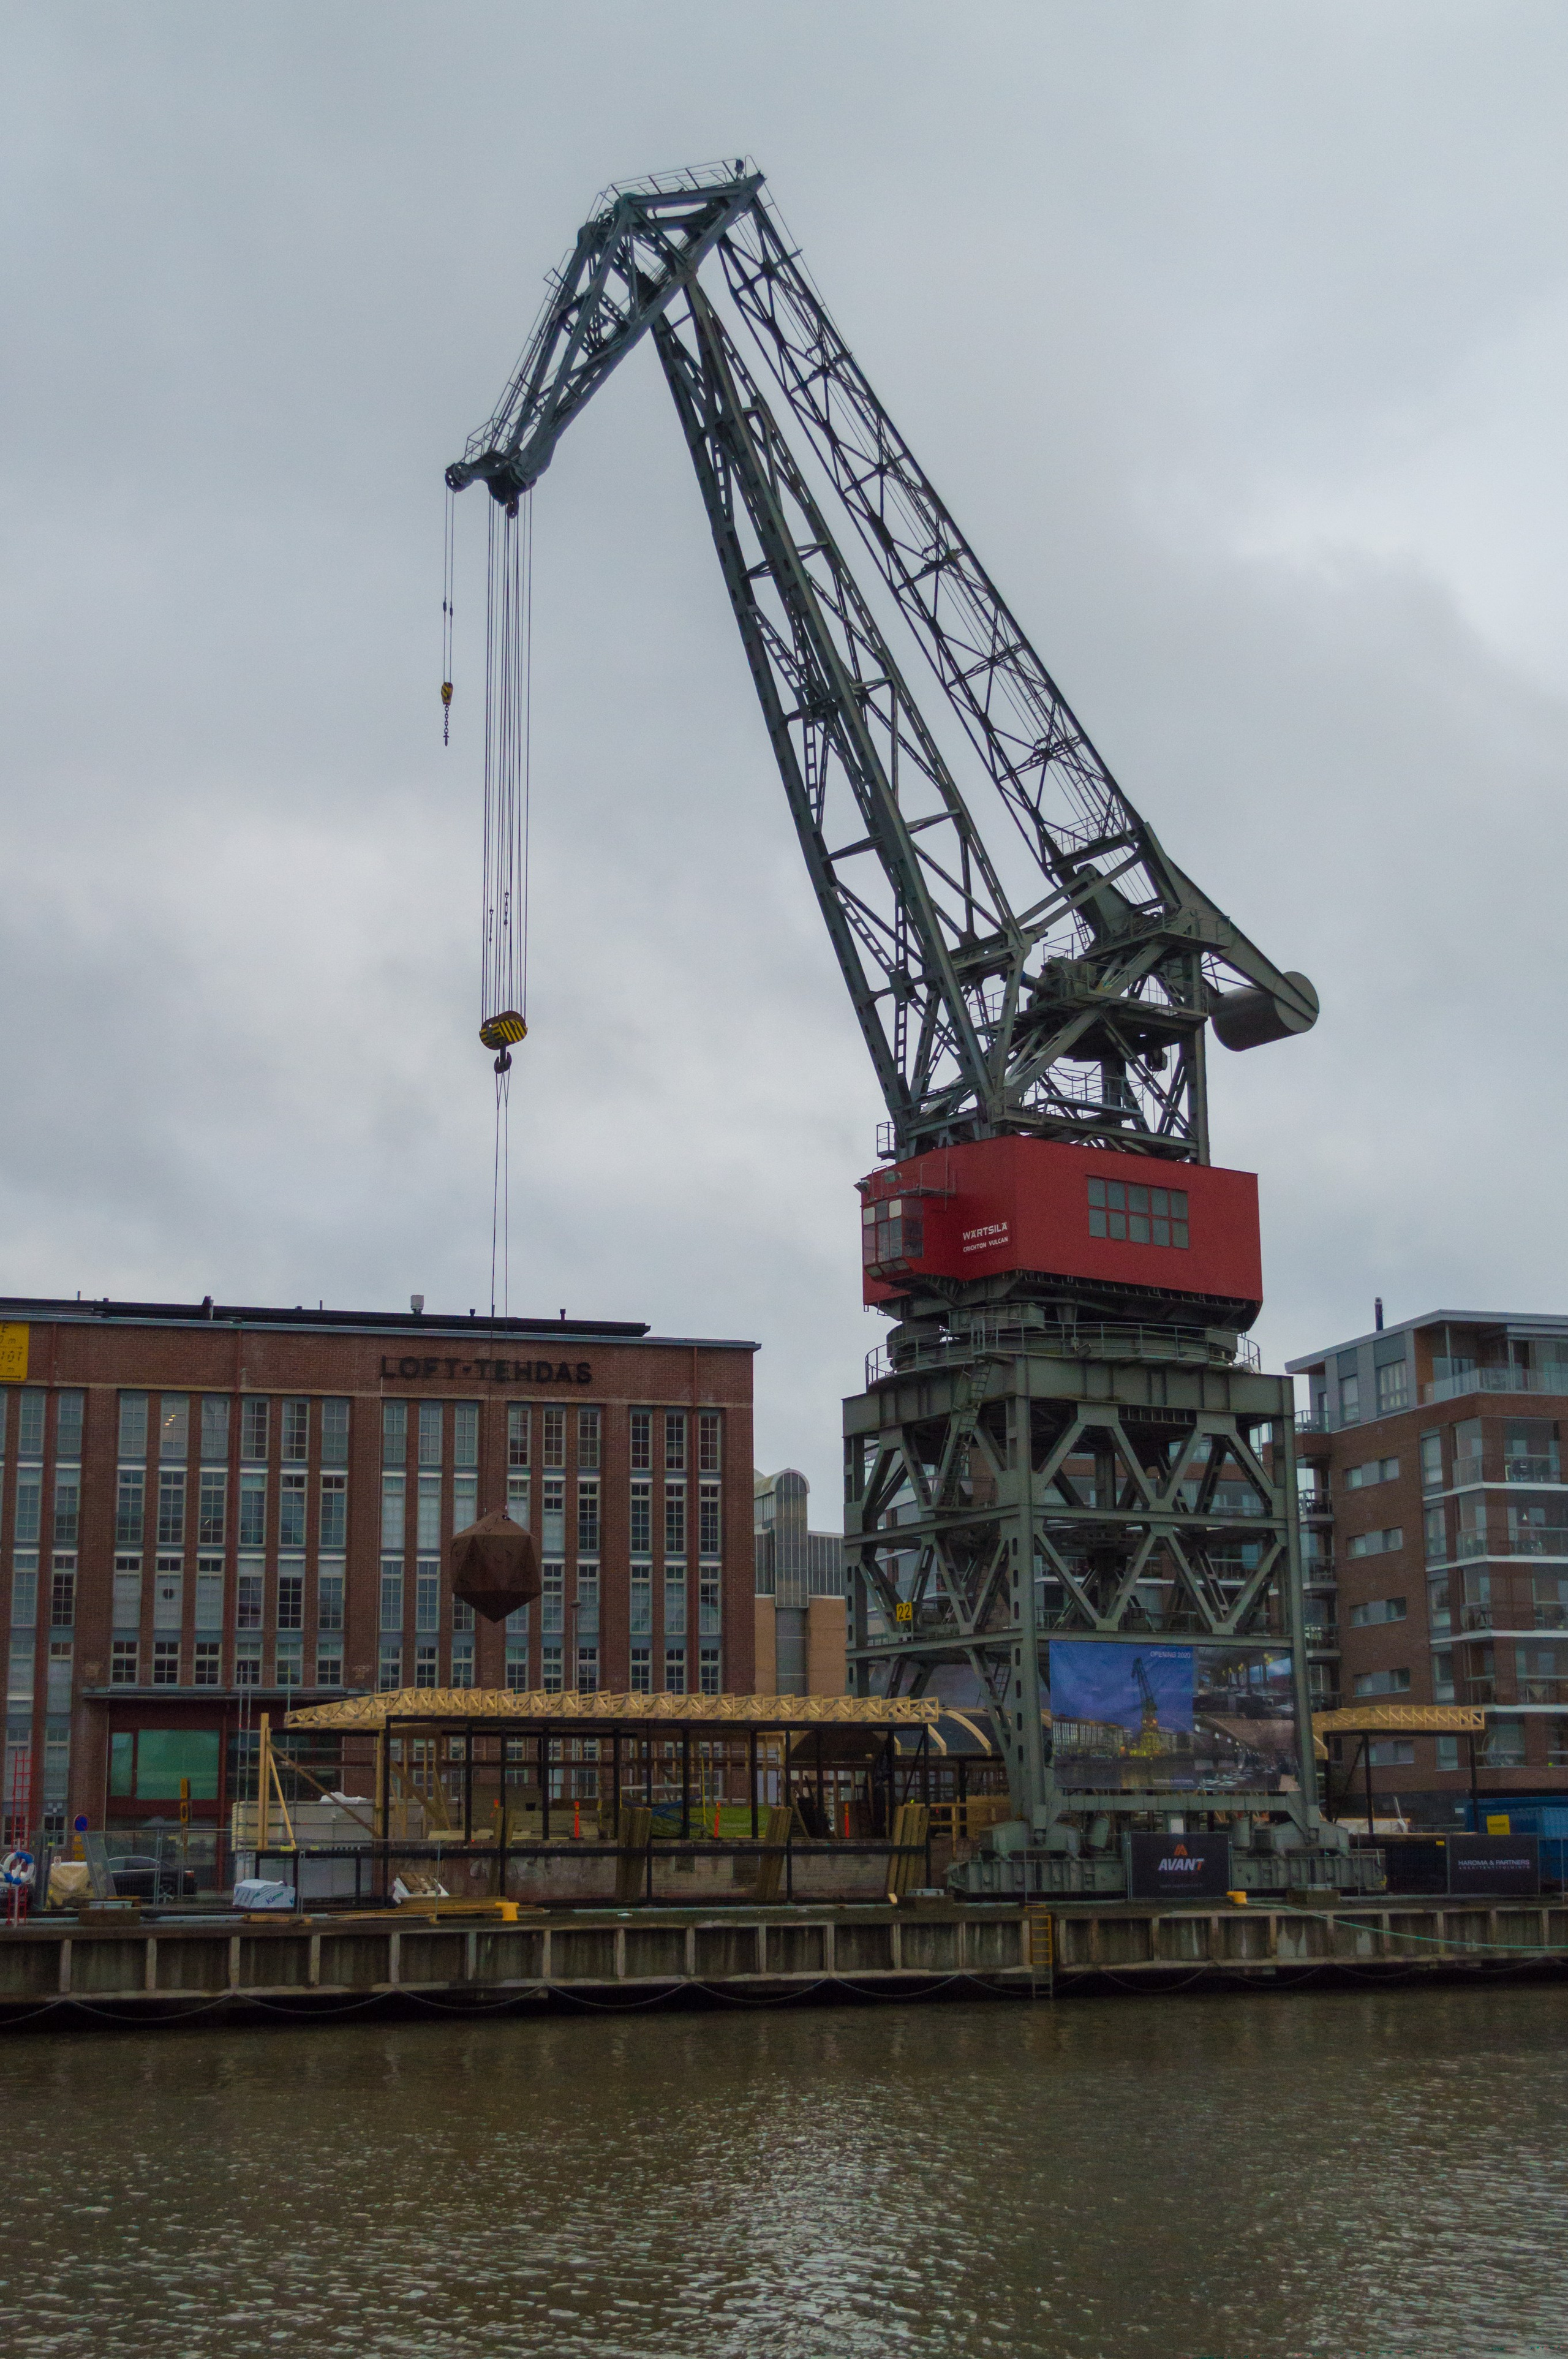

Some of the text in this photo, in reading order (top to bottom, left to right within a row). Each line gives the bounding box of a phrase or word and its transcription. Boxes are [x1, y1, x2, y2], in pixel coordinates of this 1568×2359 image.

[962, 1222, 1008, 1240] WÄRTSILÄ
[963, 1236, 1008, 1252] CRICHTON VULCAN
[898, 1605, 911, 1620] 22
[1158, 1858, 1205, 1871] AVANT
